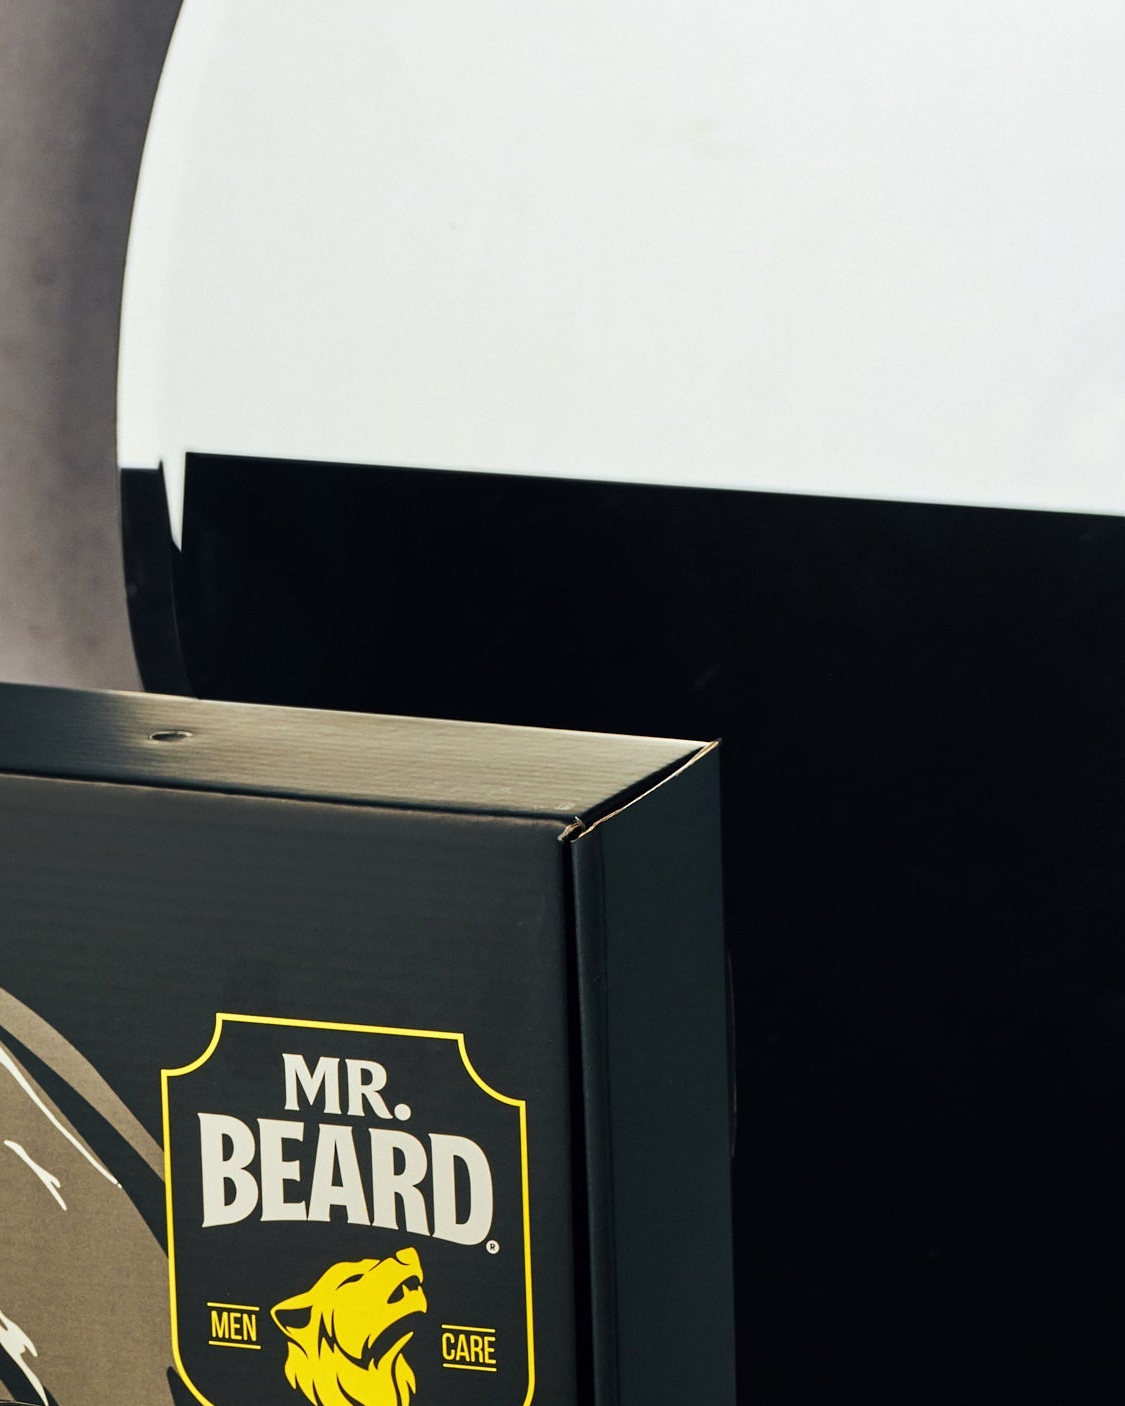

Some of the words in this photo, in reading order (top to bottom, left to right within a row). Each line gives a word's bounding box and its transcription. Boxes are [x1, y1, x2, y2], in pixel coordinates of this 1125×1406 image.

[282, 1053, 412, 1121] MR.
[211, 1310, 257, 1342] MEN
[442, 1332, 497, 1365] CARE
